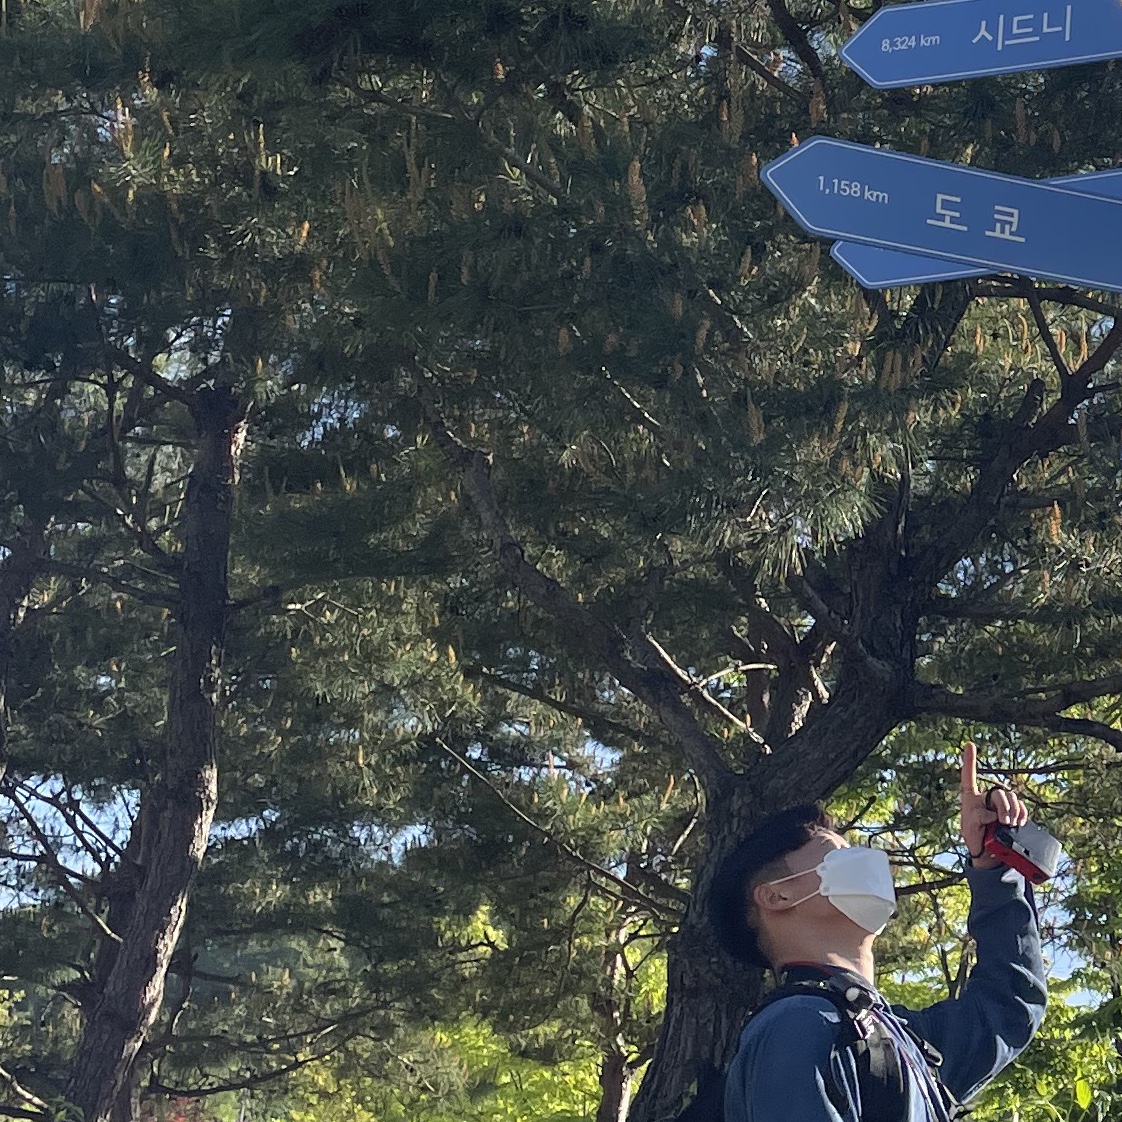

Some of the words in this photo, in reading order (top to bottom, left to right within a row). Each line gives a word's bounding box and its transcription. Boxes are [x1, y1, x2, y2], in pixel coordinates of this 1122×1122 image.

[971, 4, 1072, 51] 시드니
[881, 35, 917, 53] 8,324
[919, 33, 940, 47] km
[817, 175, 861, 199] 1,158
[863, 184, 889, 204] km
